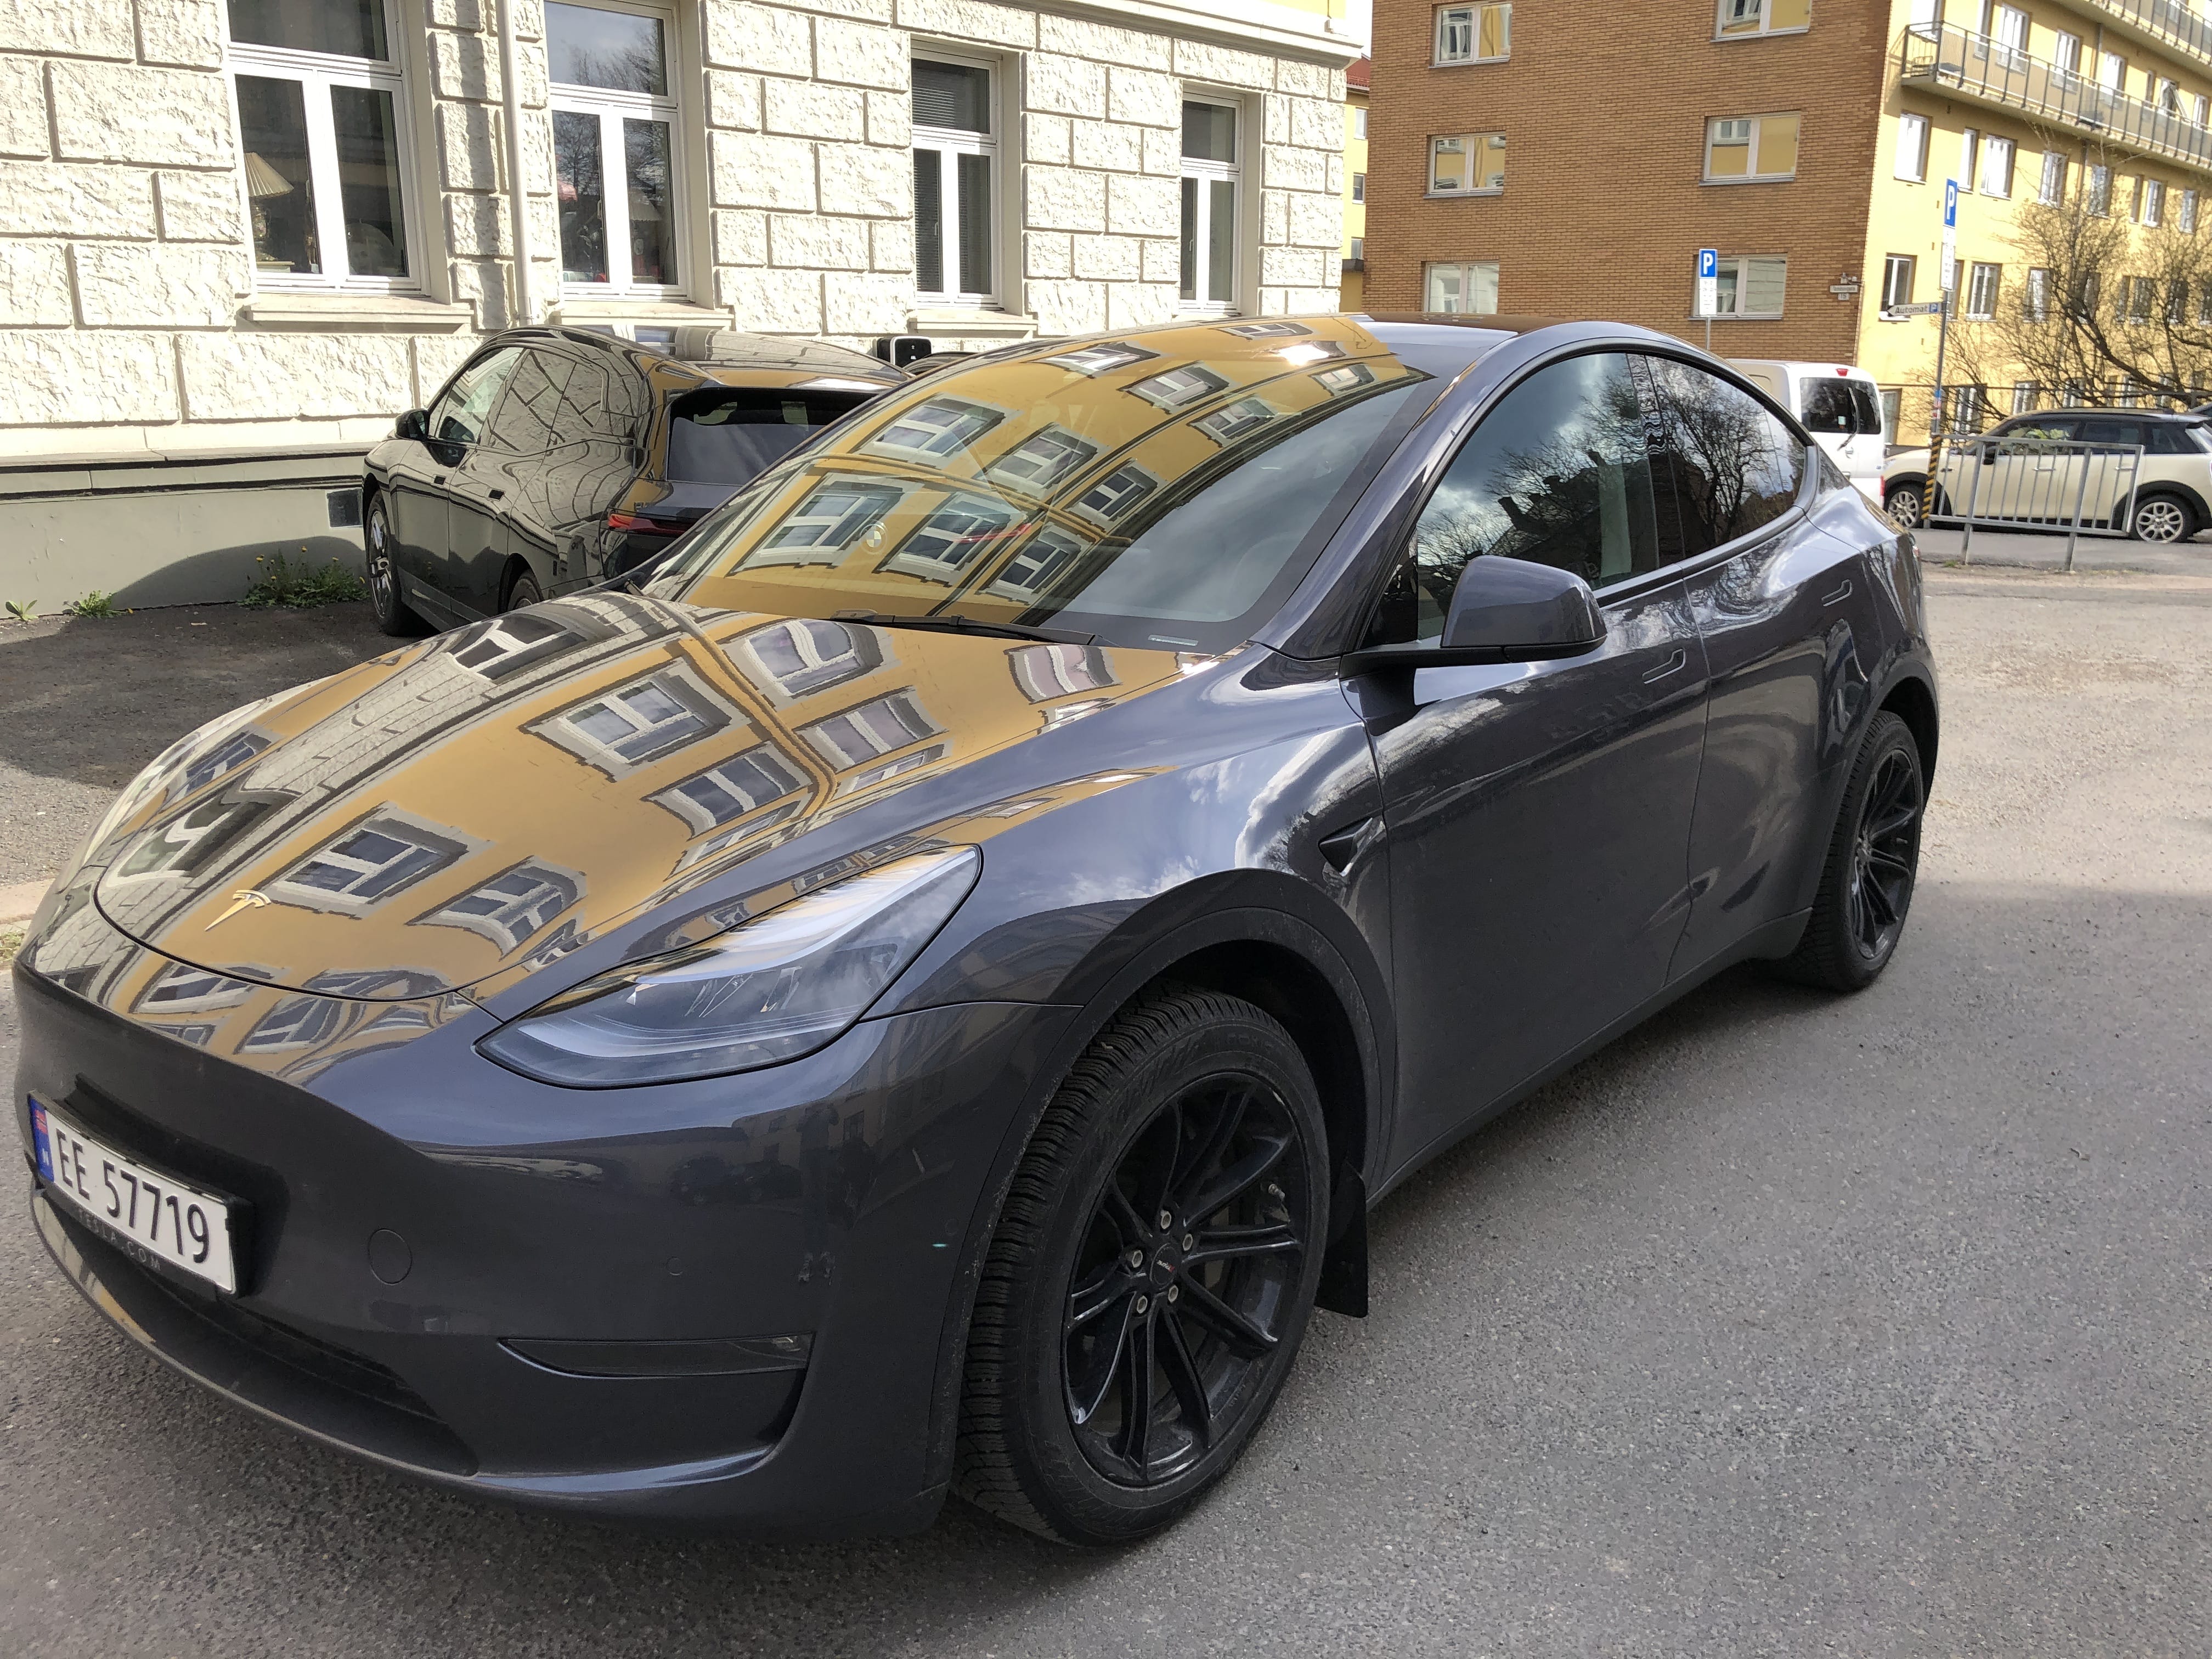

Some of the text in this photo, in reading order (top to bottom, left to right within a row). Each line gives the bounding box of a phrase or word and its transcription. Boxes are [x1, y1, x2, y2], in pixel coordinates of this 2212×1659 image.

[1946, 185, 1955, 219] P
[1703, 253, 1713, 274] P
[1895, 305, 1928, 313] Automat
[42, 1148, 49, 1165] N
[56, 1127, 210, 1263] EE 57719
